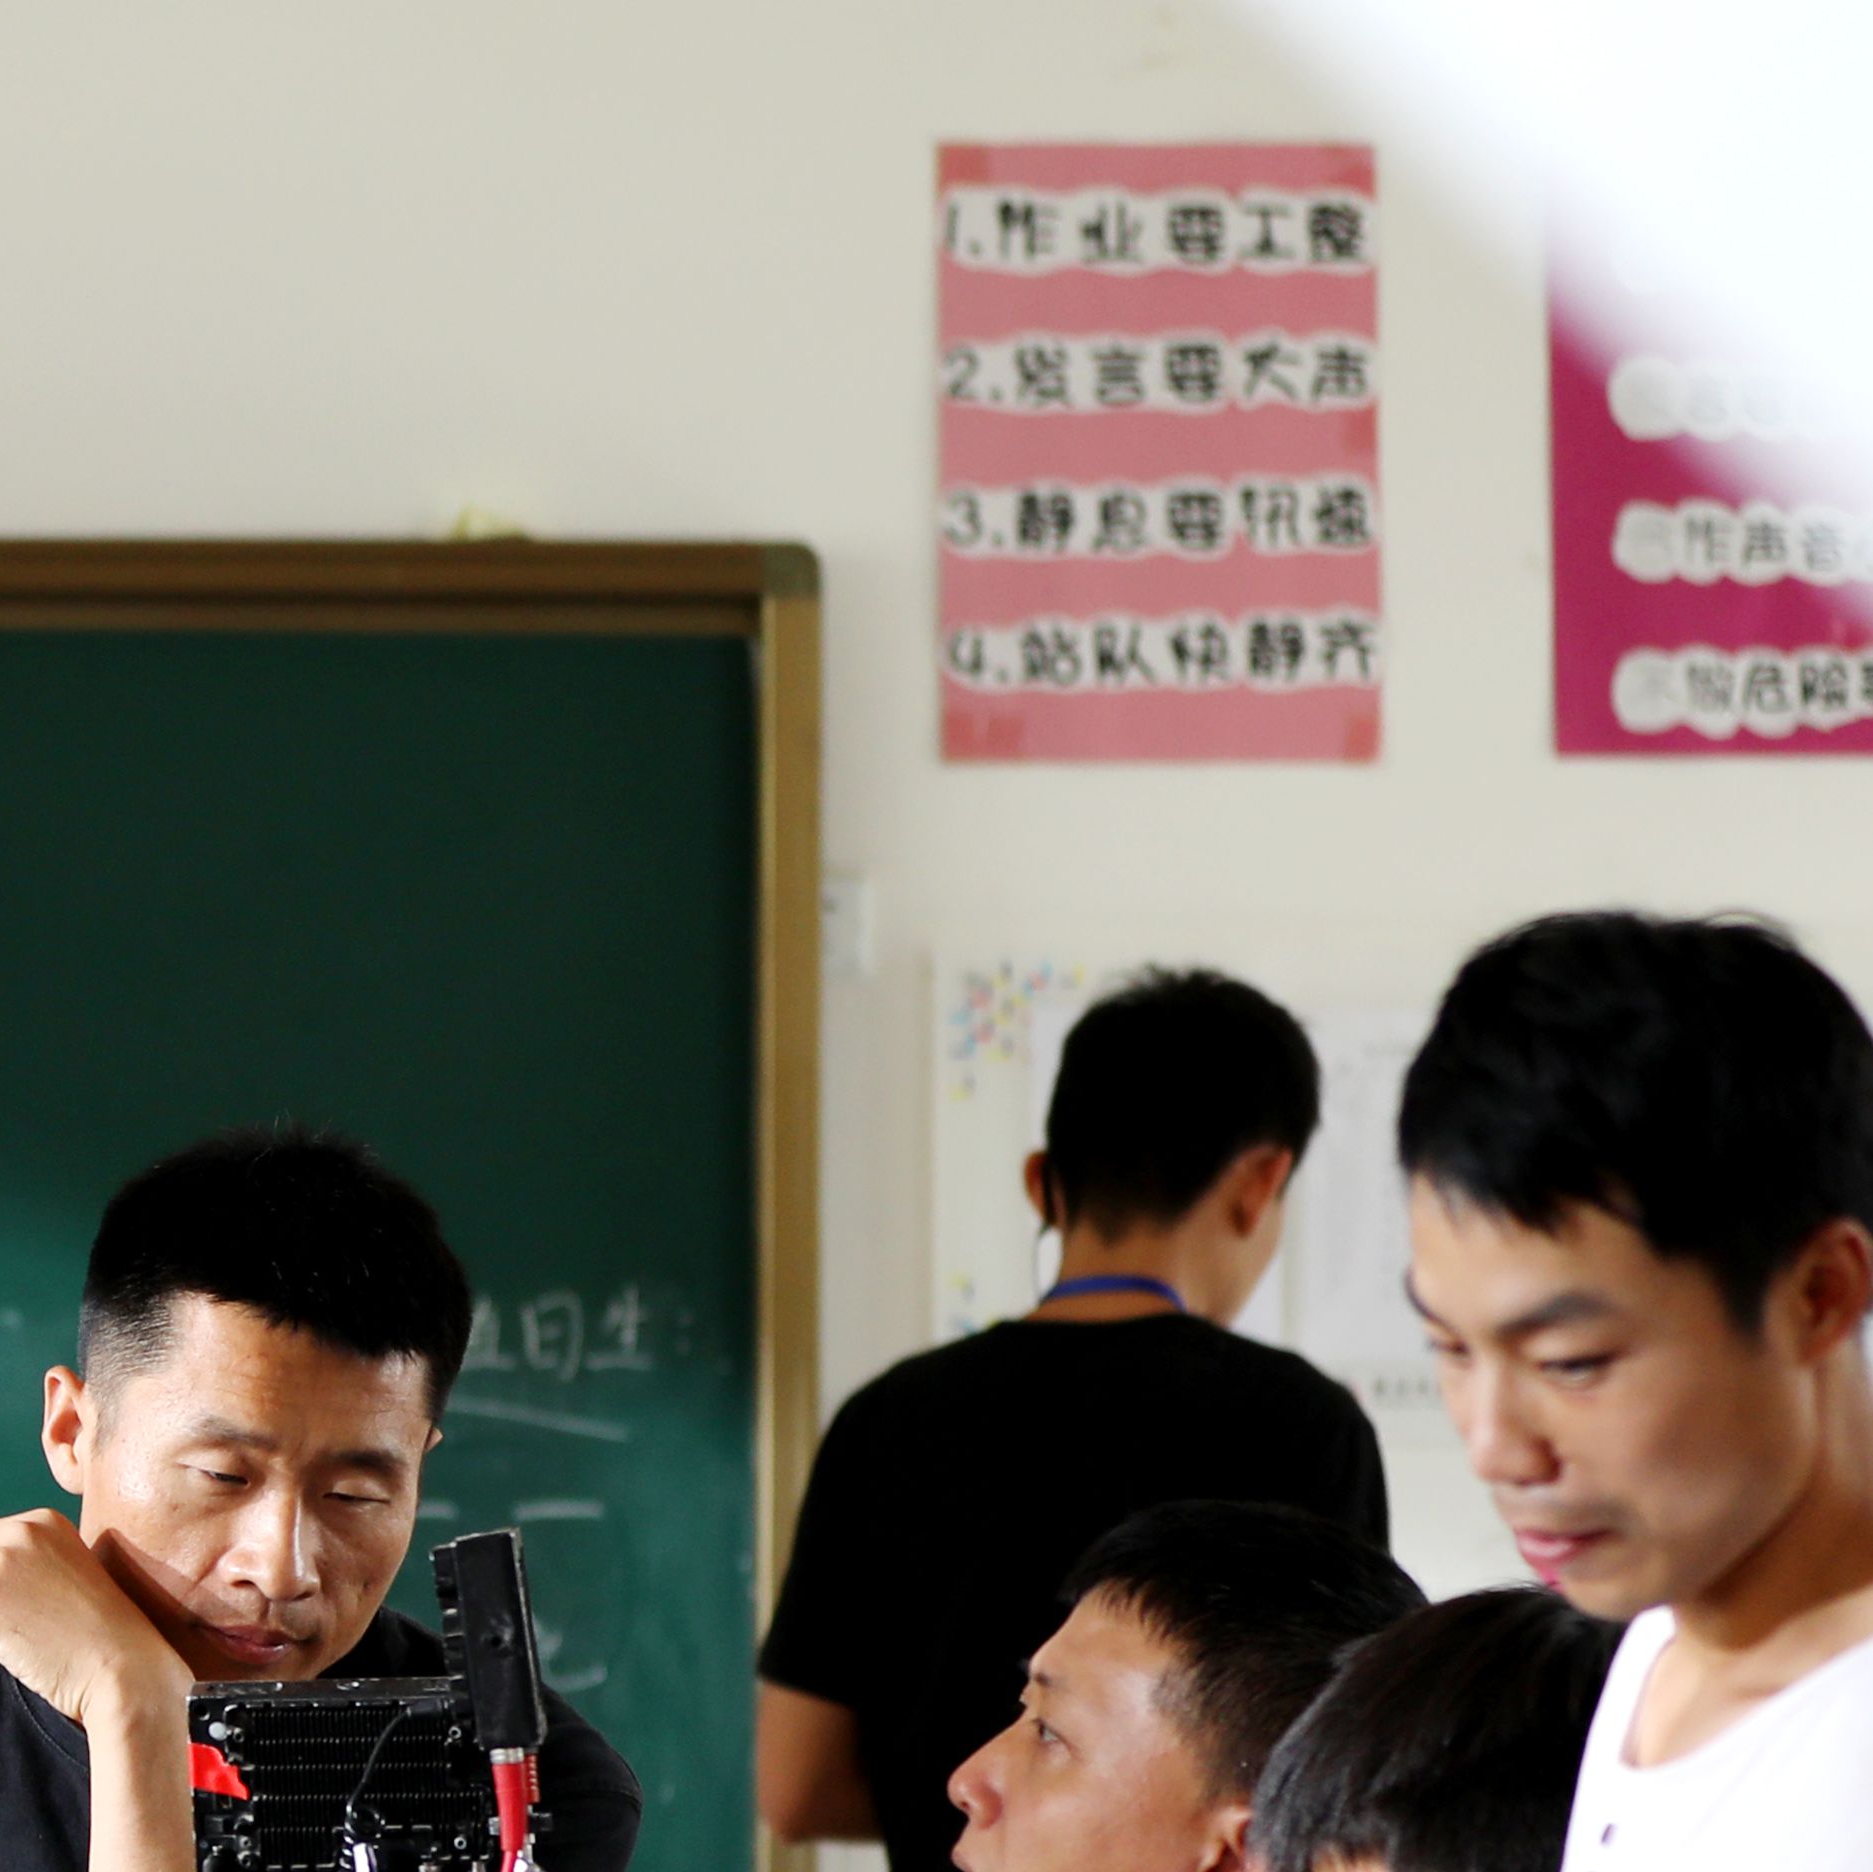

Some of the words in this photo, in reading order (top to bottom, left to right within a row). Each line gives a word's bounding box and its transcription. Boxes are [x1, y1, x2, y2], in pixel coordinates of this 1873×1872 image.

[946, 198, 1362, 263] 1.作业要工整
